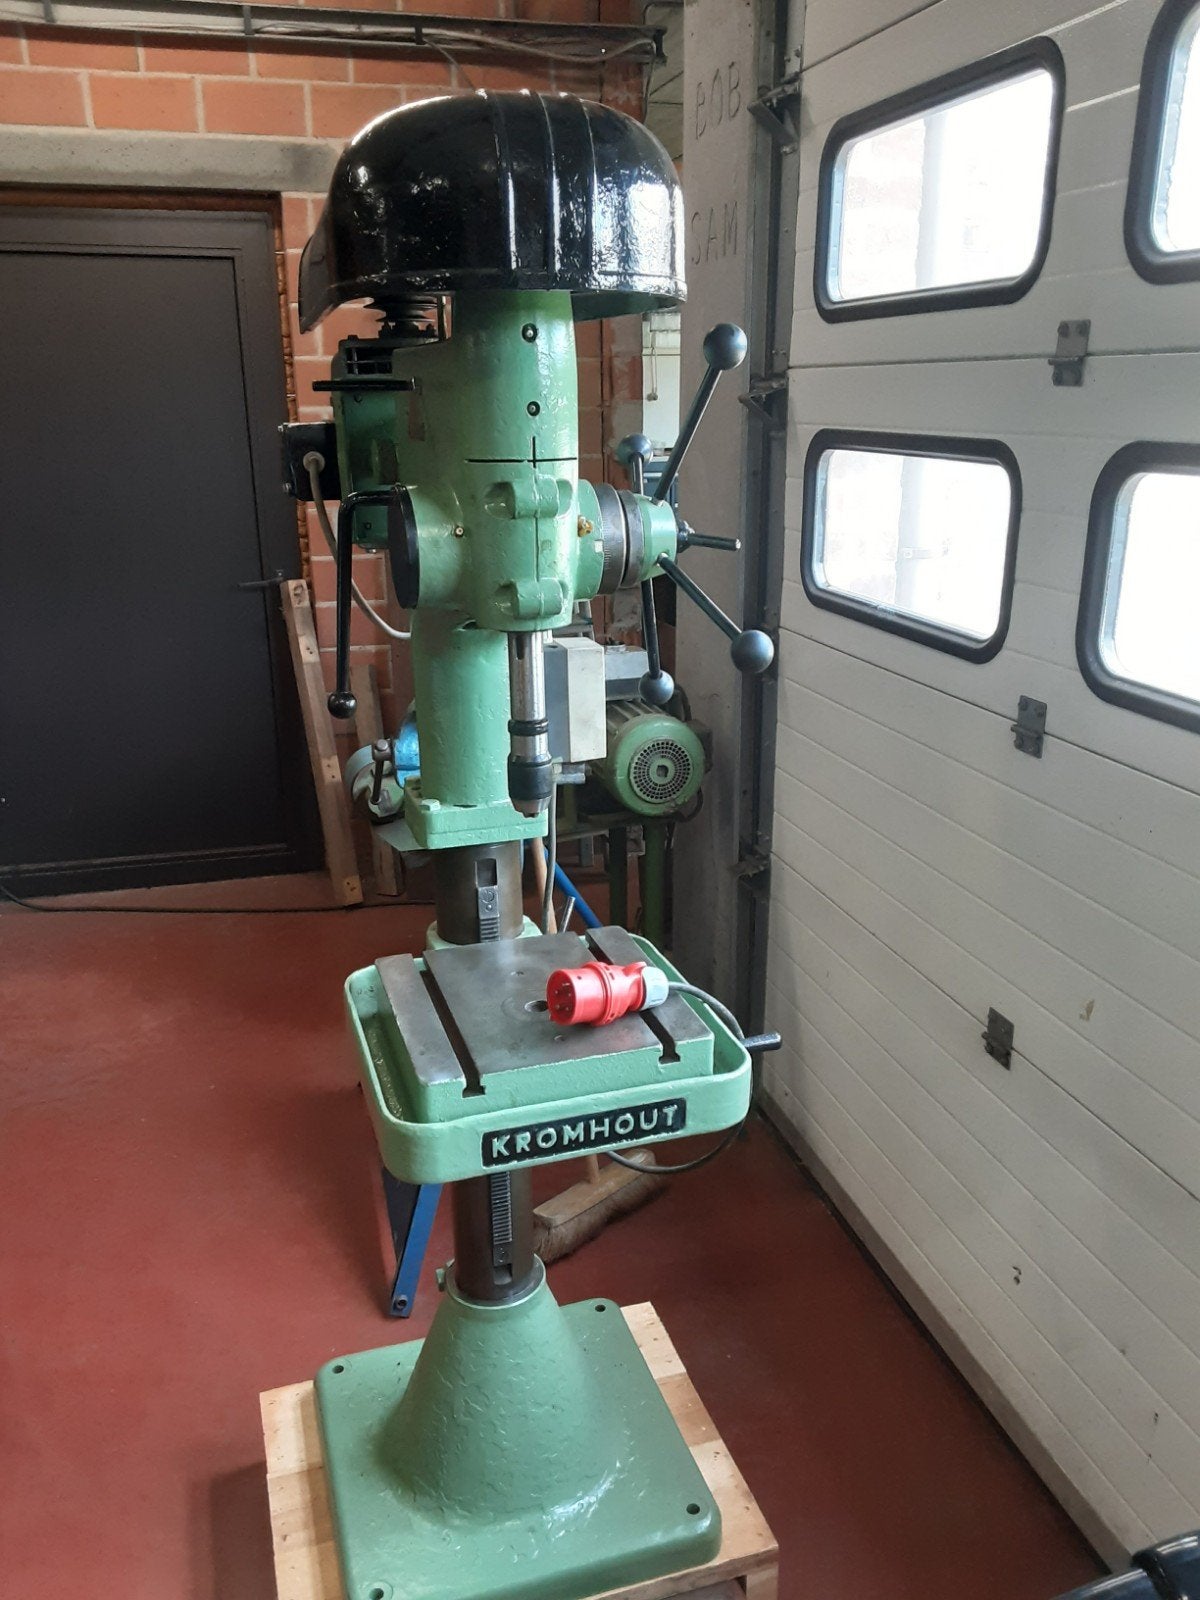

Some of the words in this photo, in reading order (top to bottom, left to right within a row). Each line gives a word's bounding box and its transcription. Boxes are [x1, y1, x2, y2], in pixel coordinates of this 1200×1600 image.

[695, 61, 741, 140] BOB
[691, 201, 738, 265] SAM
[491, 1104, 678, 1158] KROMHOUT
